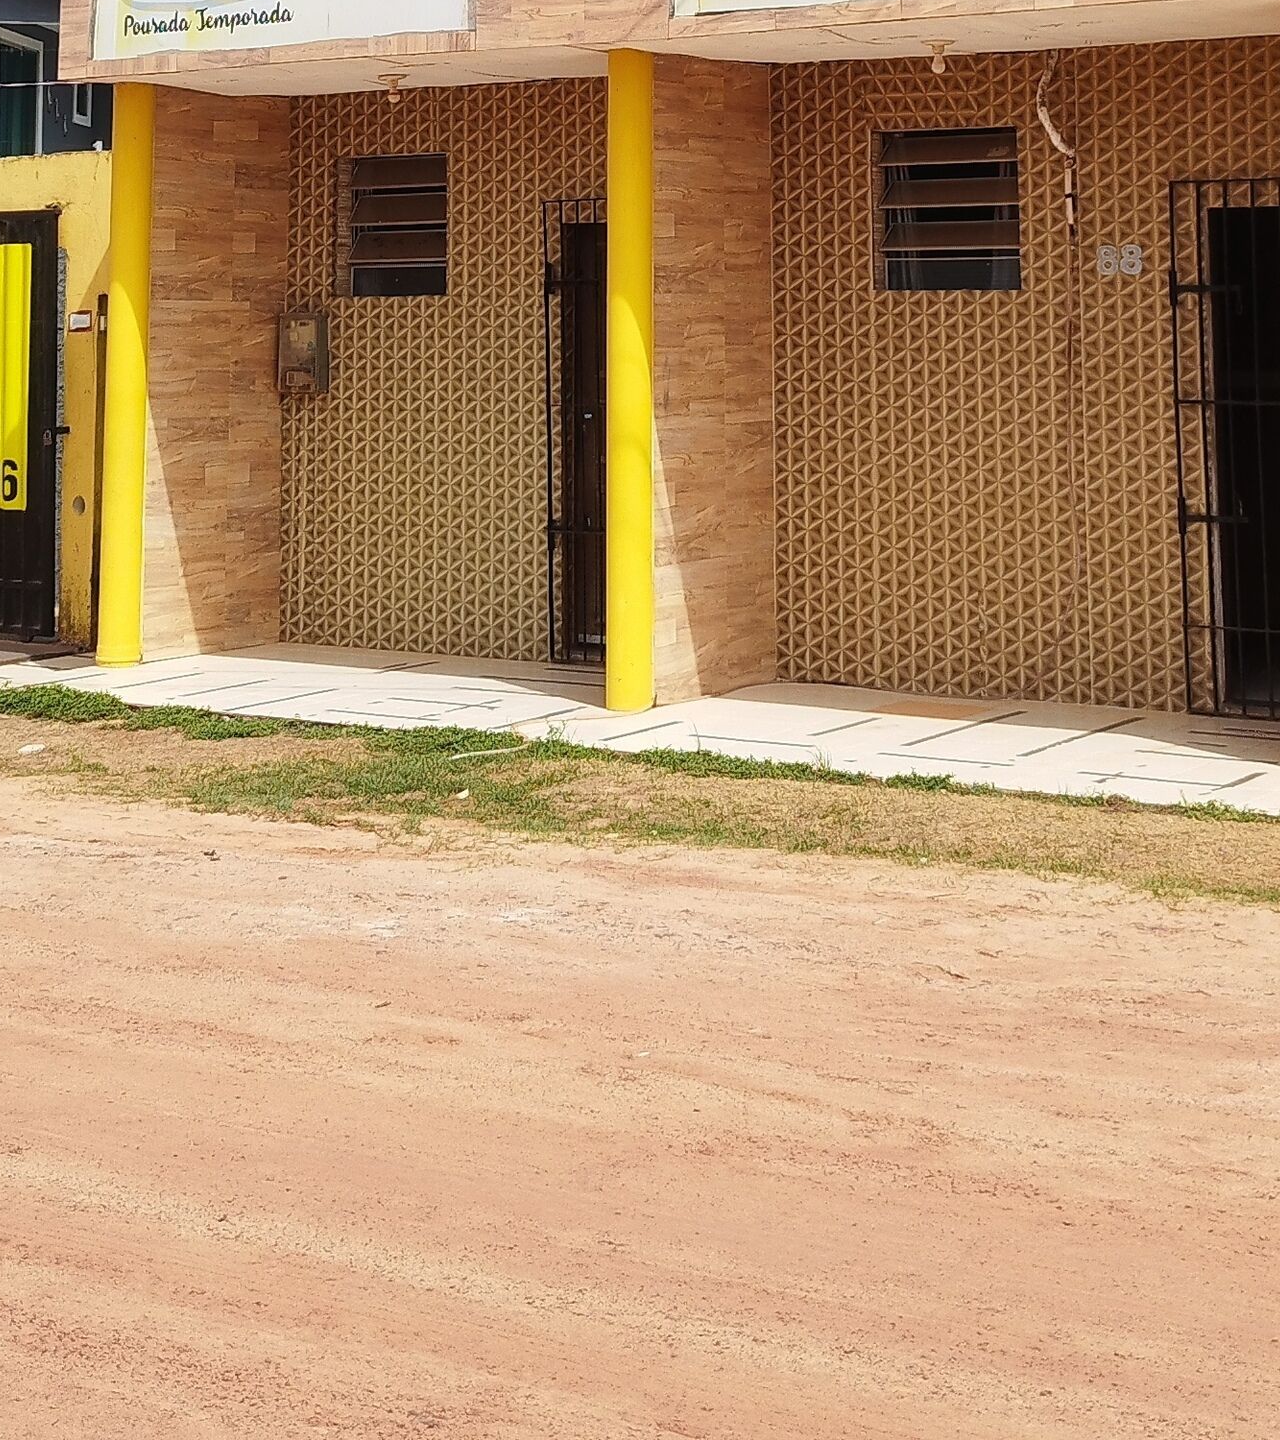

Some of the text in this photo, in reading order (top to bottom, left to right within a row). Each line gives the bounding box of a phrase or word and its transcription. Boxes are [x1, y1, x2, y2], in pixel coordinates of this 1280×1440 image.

[124, 1, 294, 37] Pousada Temporada
[1096, 244, 1143, 276] 88
